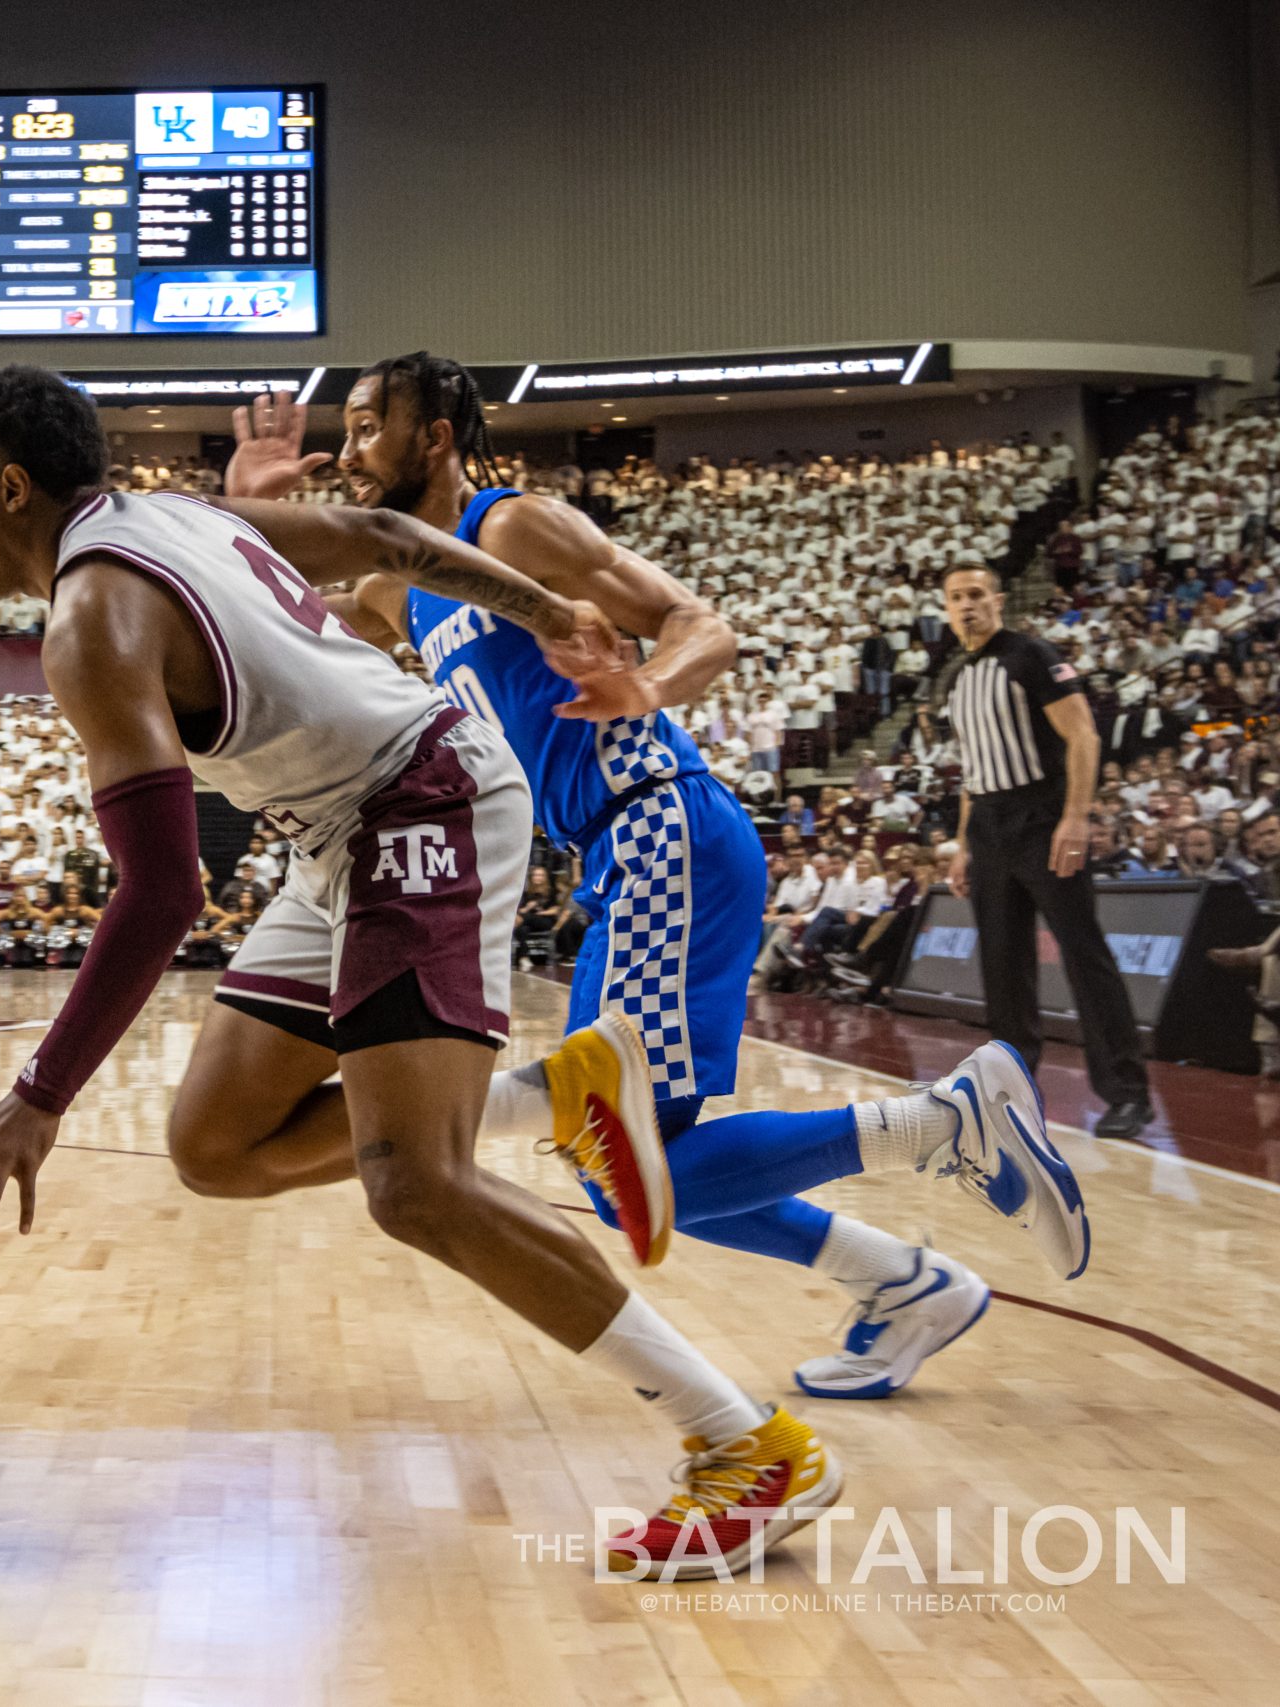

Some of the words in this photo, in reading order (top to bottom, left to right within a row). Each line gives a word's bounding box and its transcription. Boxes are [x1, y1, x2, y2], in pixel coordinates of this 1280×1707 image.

[12, 114, 74, 139] 8:23
[152, 106, 195, 142] UK
[221, 107, 270, 138] 49
